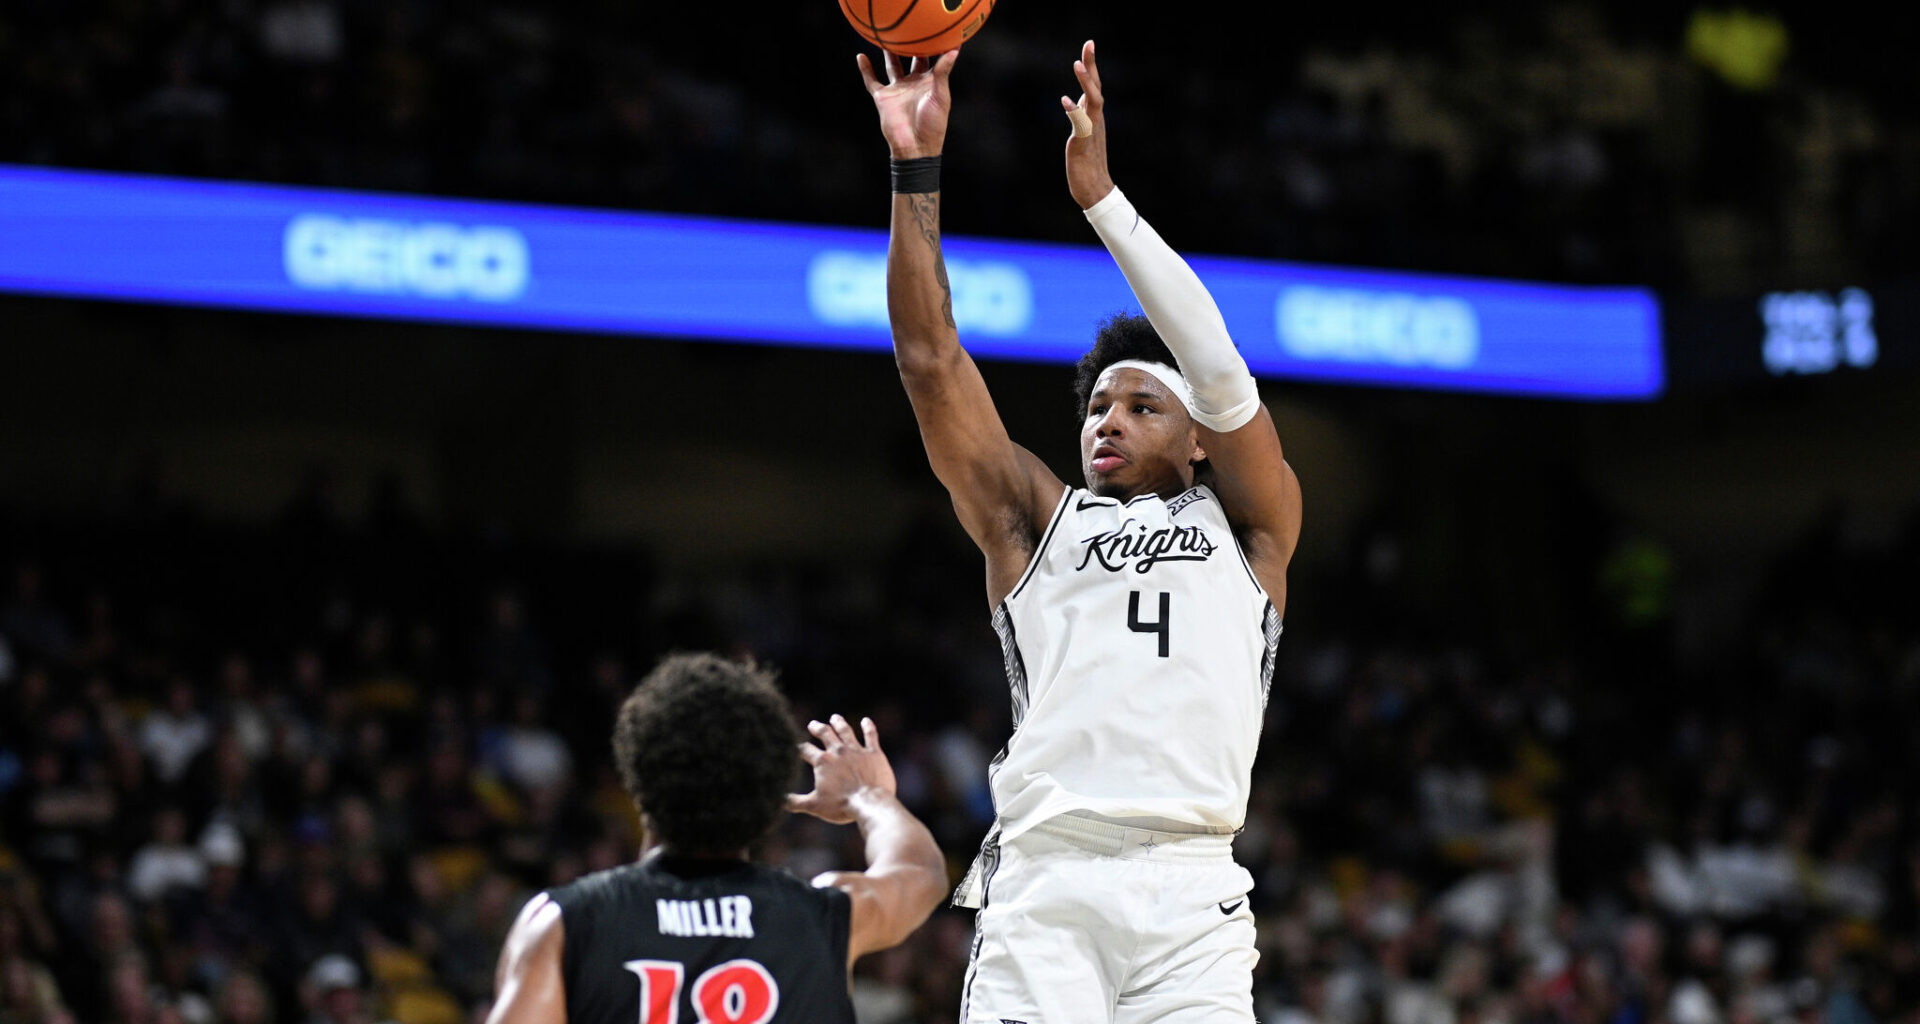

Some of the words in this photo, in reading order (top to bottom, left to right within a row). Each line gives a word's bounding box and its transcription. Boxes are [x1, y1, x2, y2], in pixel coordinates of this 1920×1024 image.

[284, 213, 530, 301] GEICO
[1076, 518, 1218, 574] Knights
[1127, 591, 1170, 657] 4
[656, 895, 754, 938] MILLER
